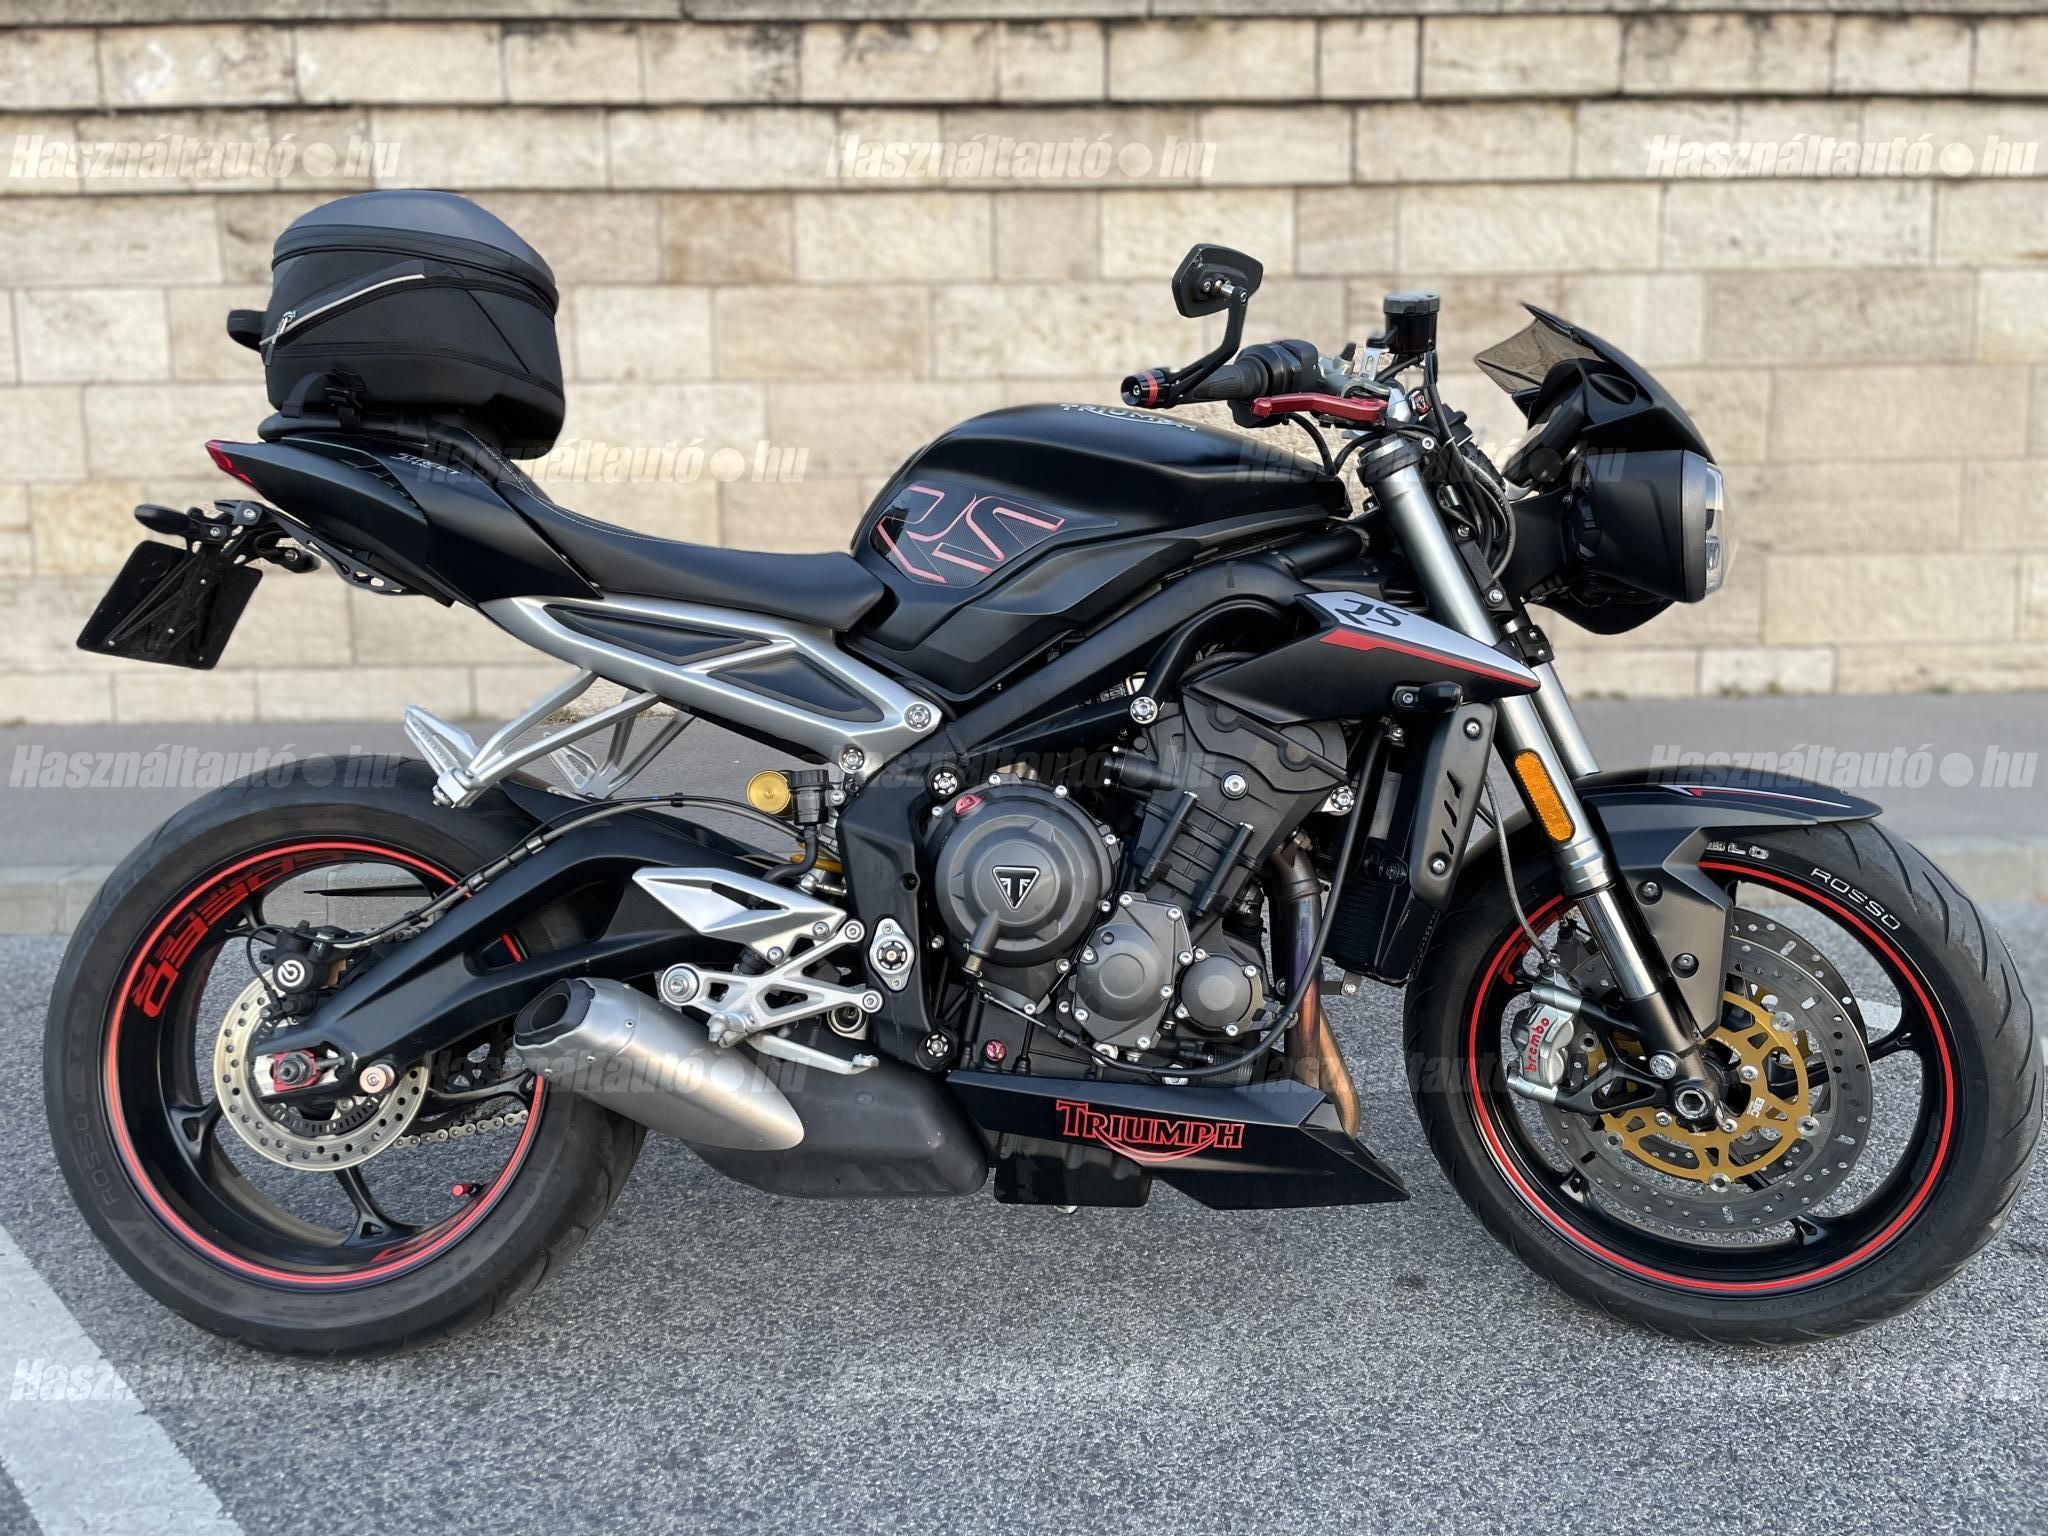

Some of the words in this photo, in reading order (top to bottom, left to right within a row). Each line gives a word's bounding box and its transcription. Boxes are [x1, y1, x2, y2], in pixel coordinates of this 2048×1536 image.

[1810, 867, 1901, 931] ROSSO
[1525, 1017, 1550, 1073] brembo
[1056, 1100, 1245, 1150] TRIUMPH
